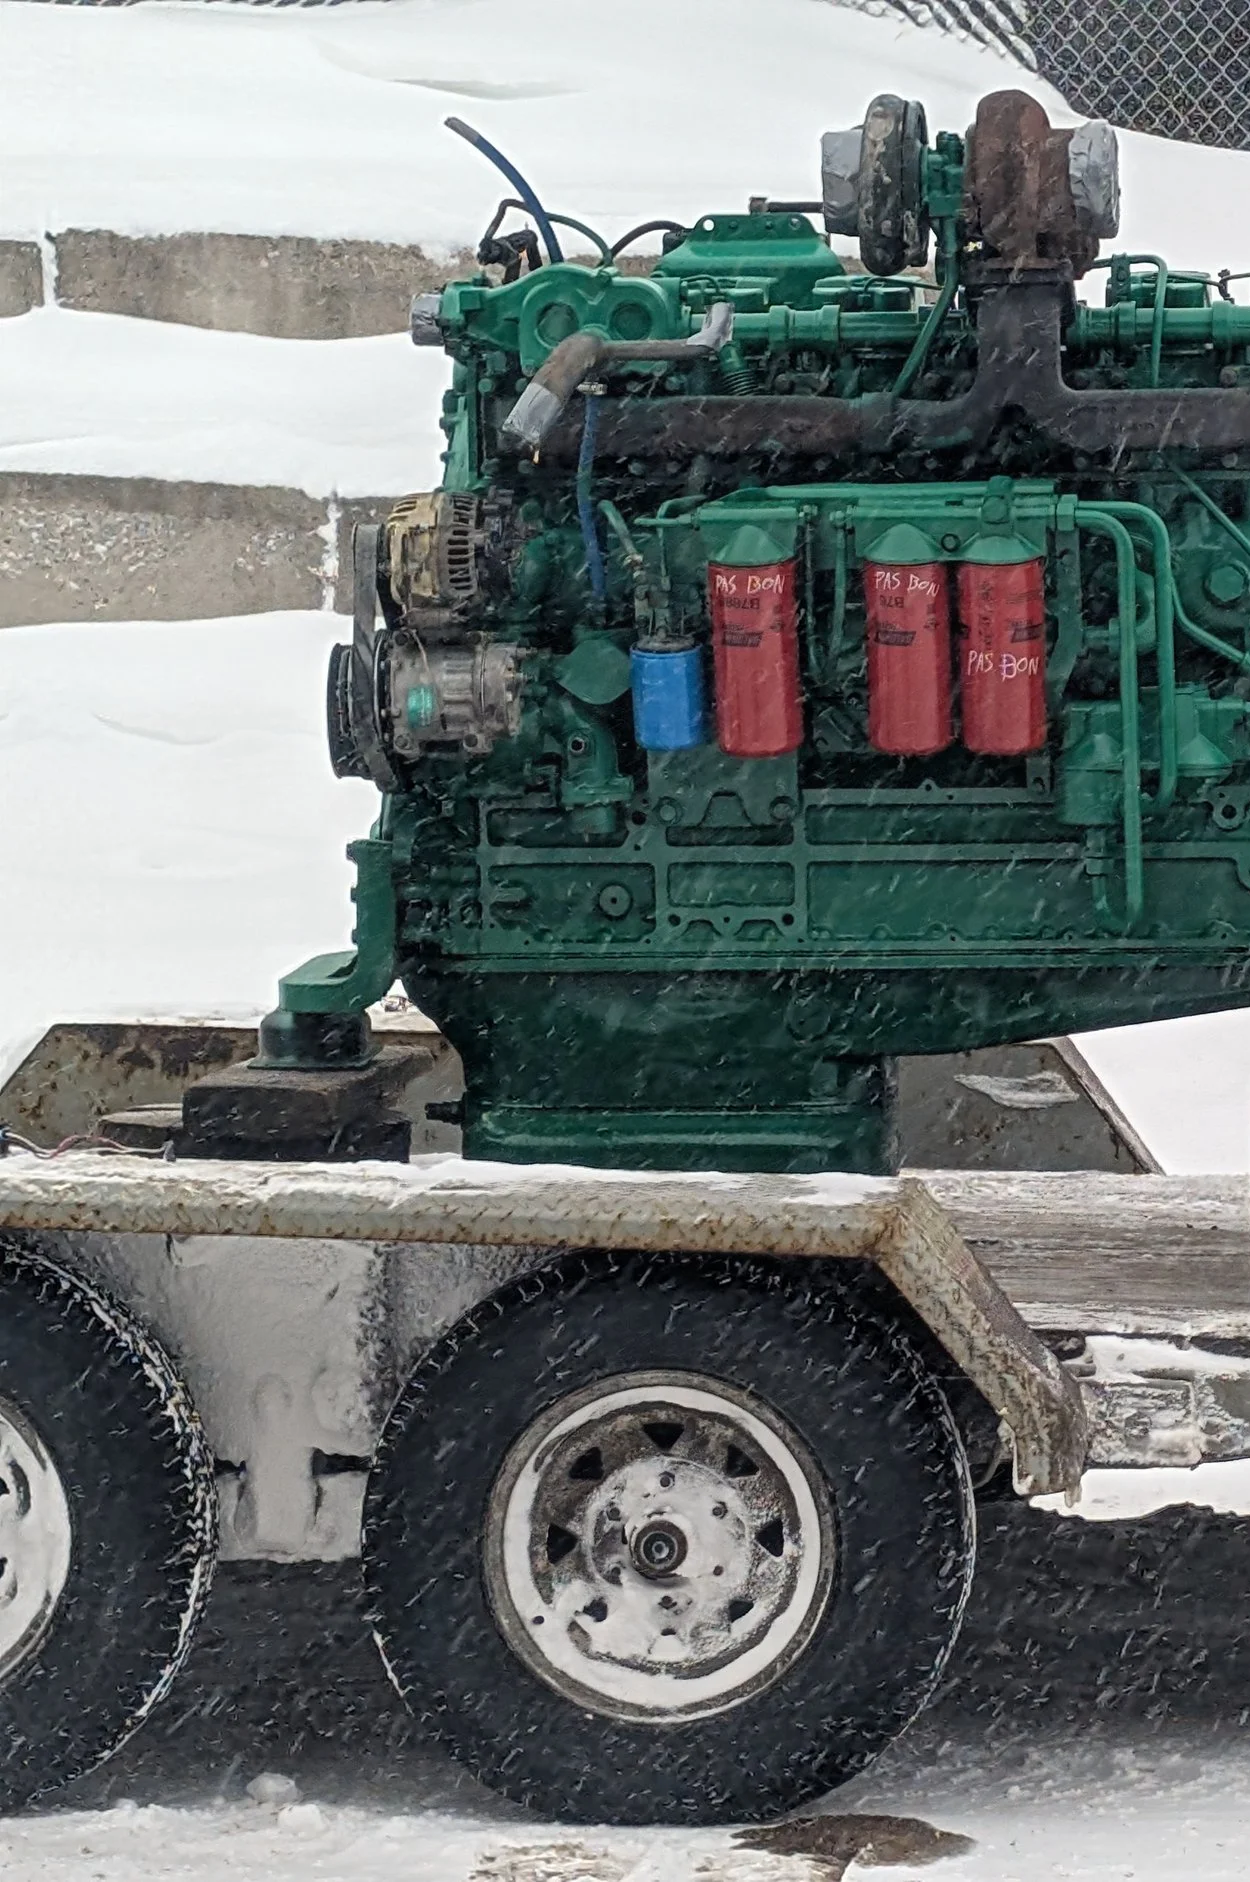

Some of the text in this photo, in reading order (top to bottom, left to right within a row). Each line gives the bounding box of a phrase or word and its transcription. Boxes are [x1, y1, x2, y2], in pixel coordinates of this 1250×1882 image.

[715, 574, 785, 594] PAS BON
[875, 571, 940, 597] PAS BON
[967, 651, 1039, 682] PAS BON
